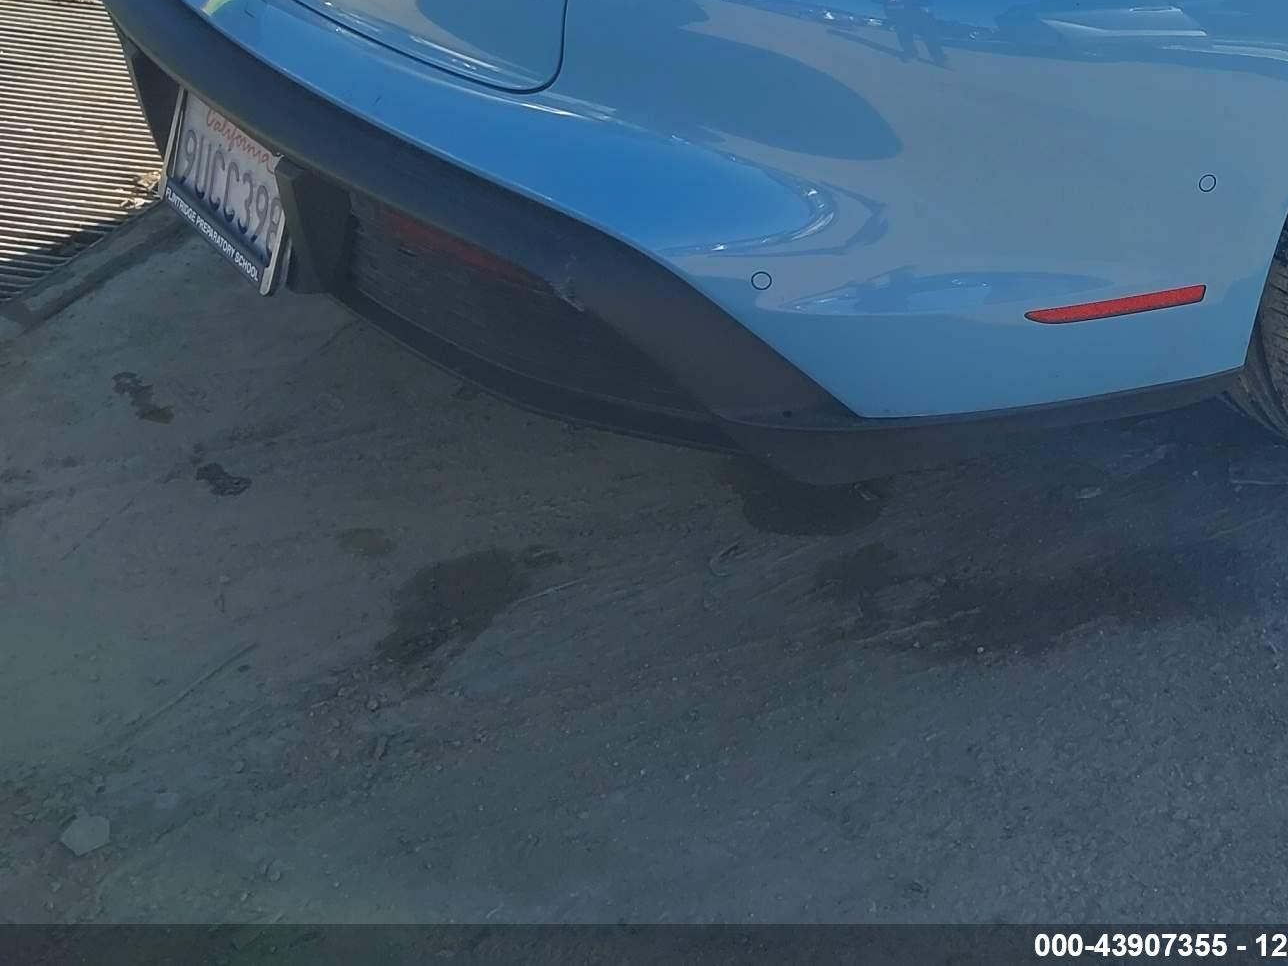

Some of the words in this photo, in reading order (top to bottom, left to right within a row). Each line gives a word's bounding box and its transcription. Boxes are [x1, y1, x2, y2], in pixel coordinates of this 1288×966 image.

[165, 186, 197, 224] FLINTRIDGE
[195, 214, 236, 258] PREPARATORY
[234, 251, 259, 282] SCHOOL
[181, 129, 281, 257] 9UCC398
